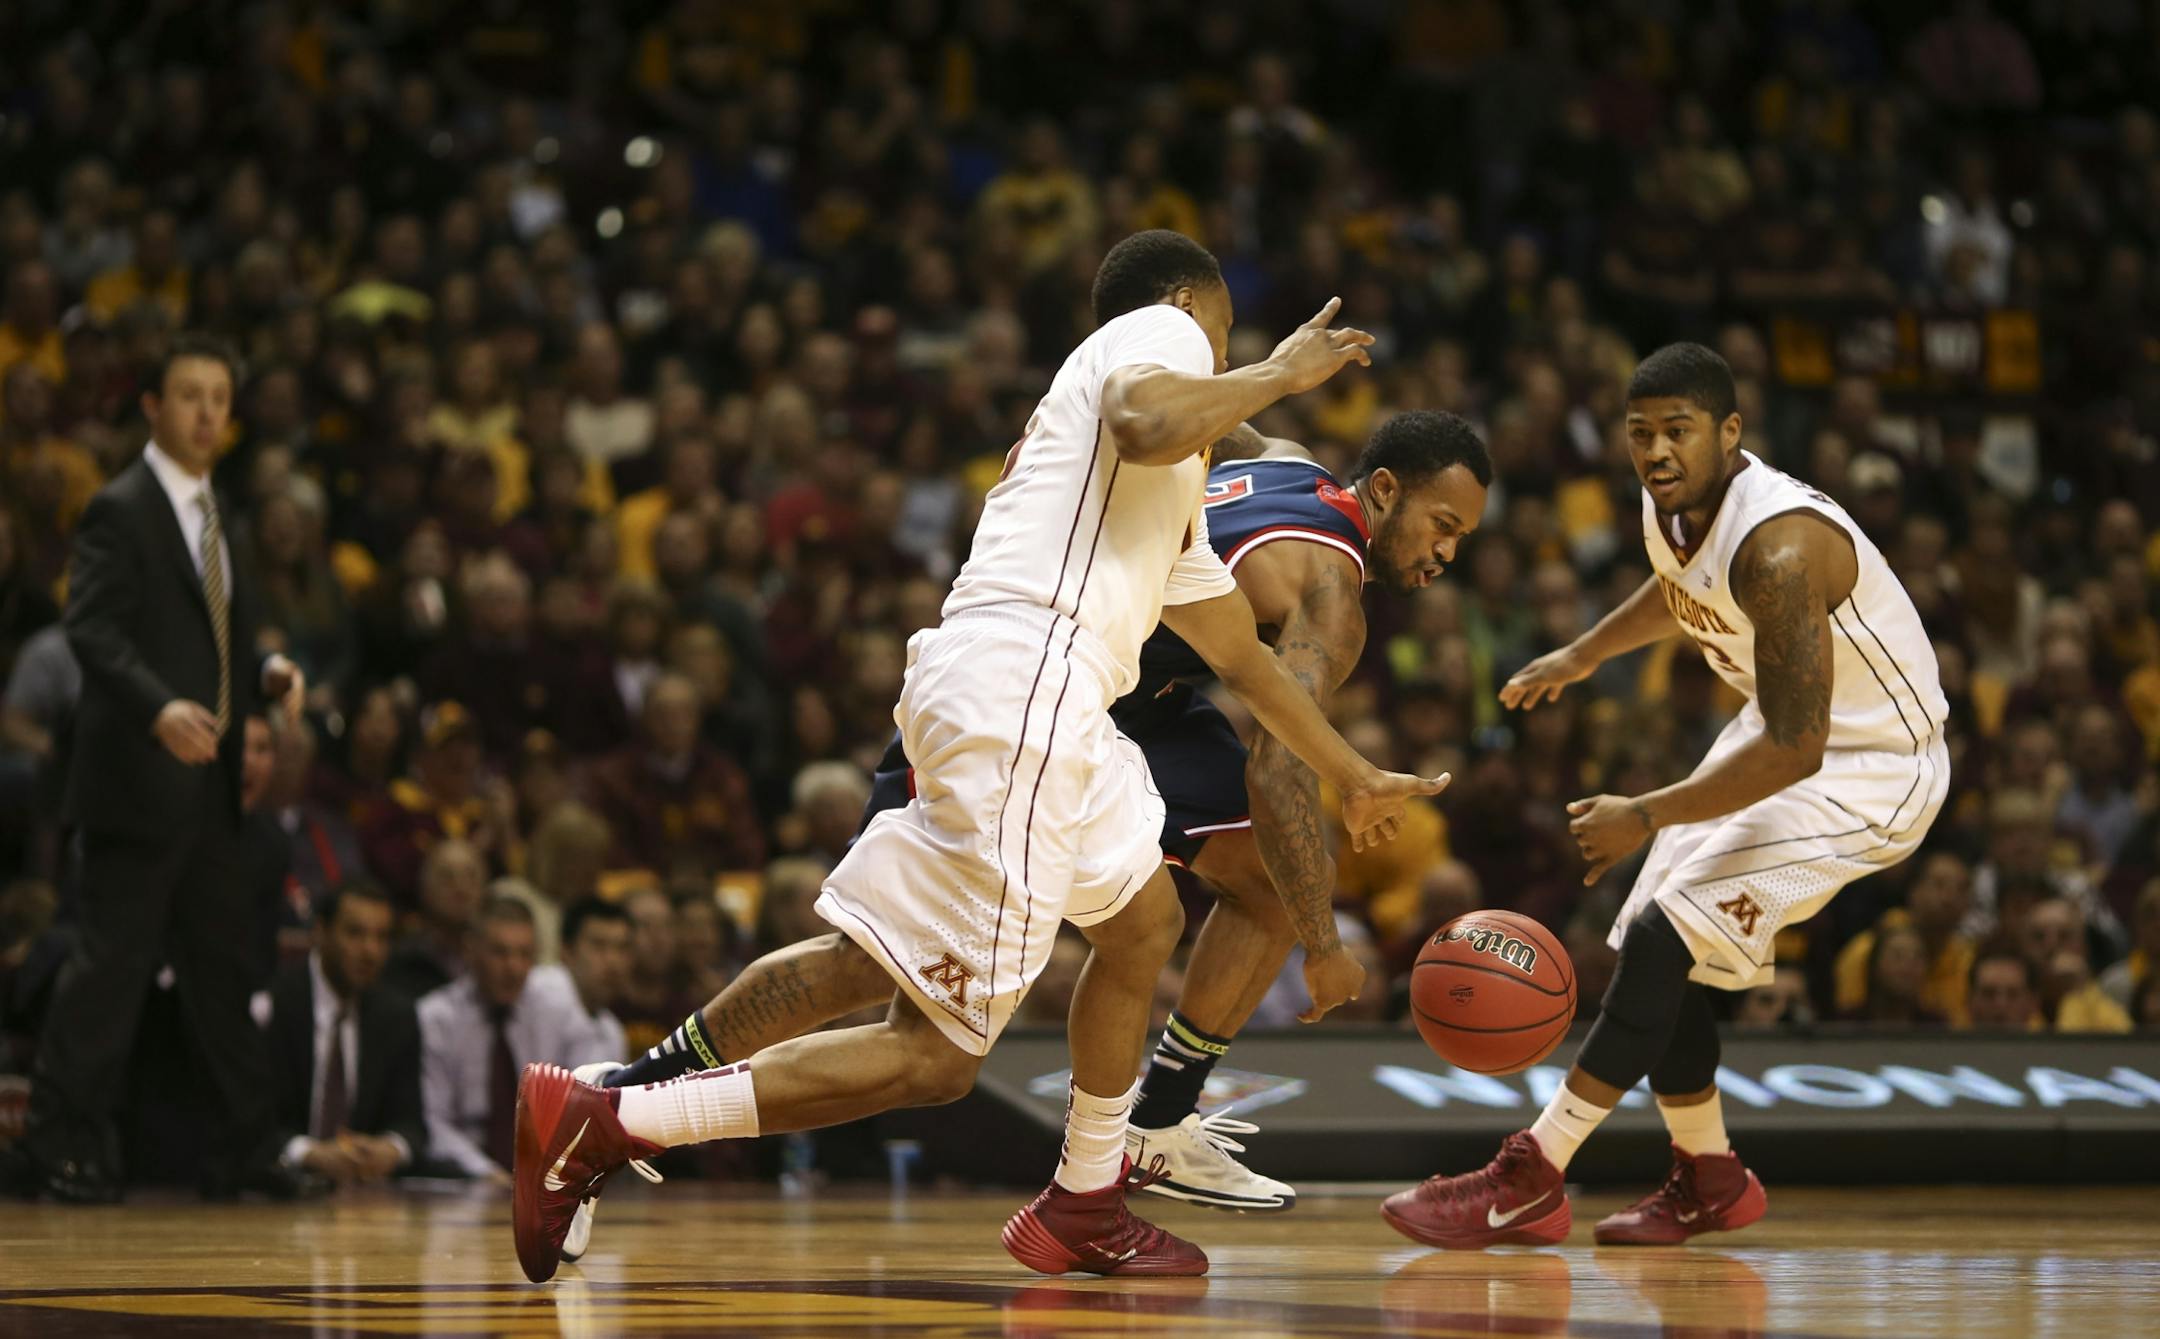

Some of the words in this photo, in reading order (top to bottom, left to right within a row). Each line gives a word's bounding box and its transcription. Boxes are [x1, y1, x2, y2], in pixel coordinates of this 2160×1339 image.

[1715, 891, 1764, 937] M
[1431, 926, 1538, 976] Wilson
[918, 952, 975, 1008] M
[688, 1020, 712, 1063] TEAM
